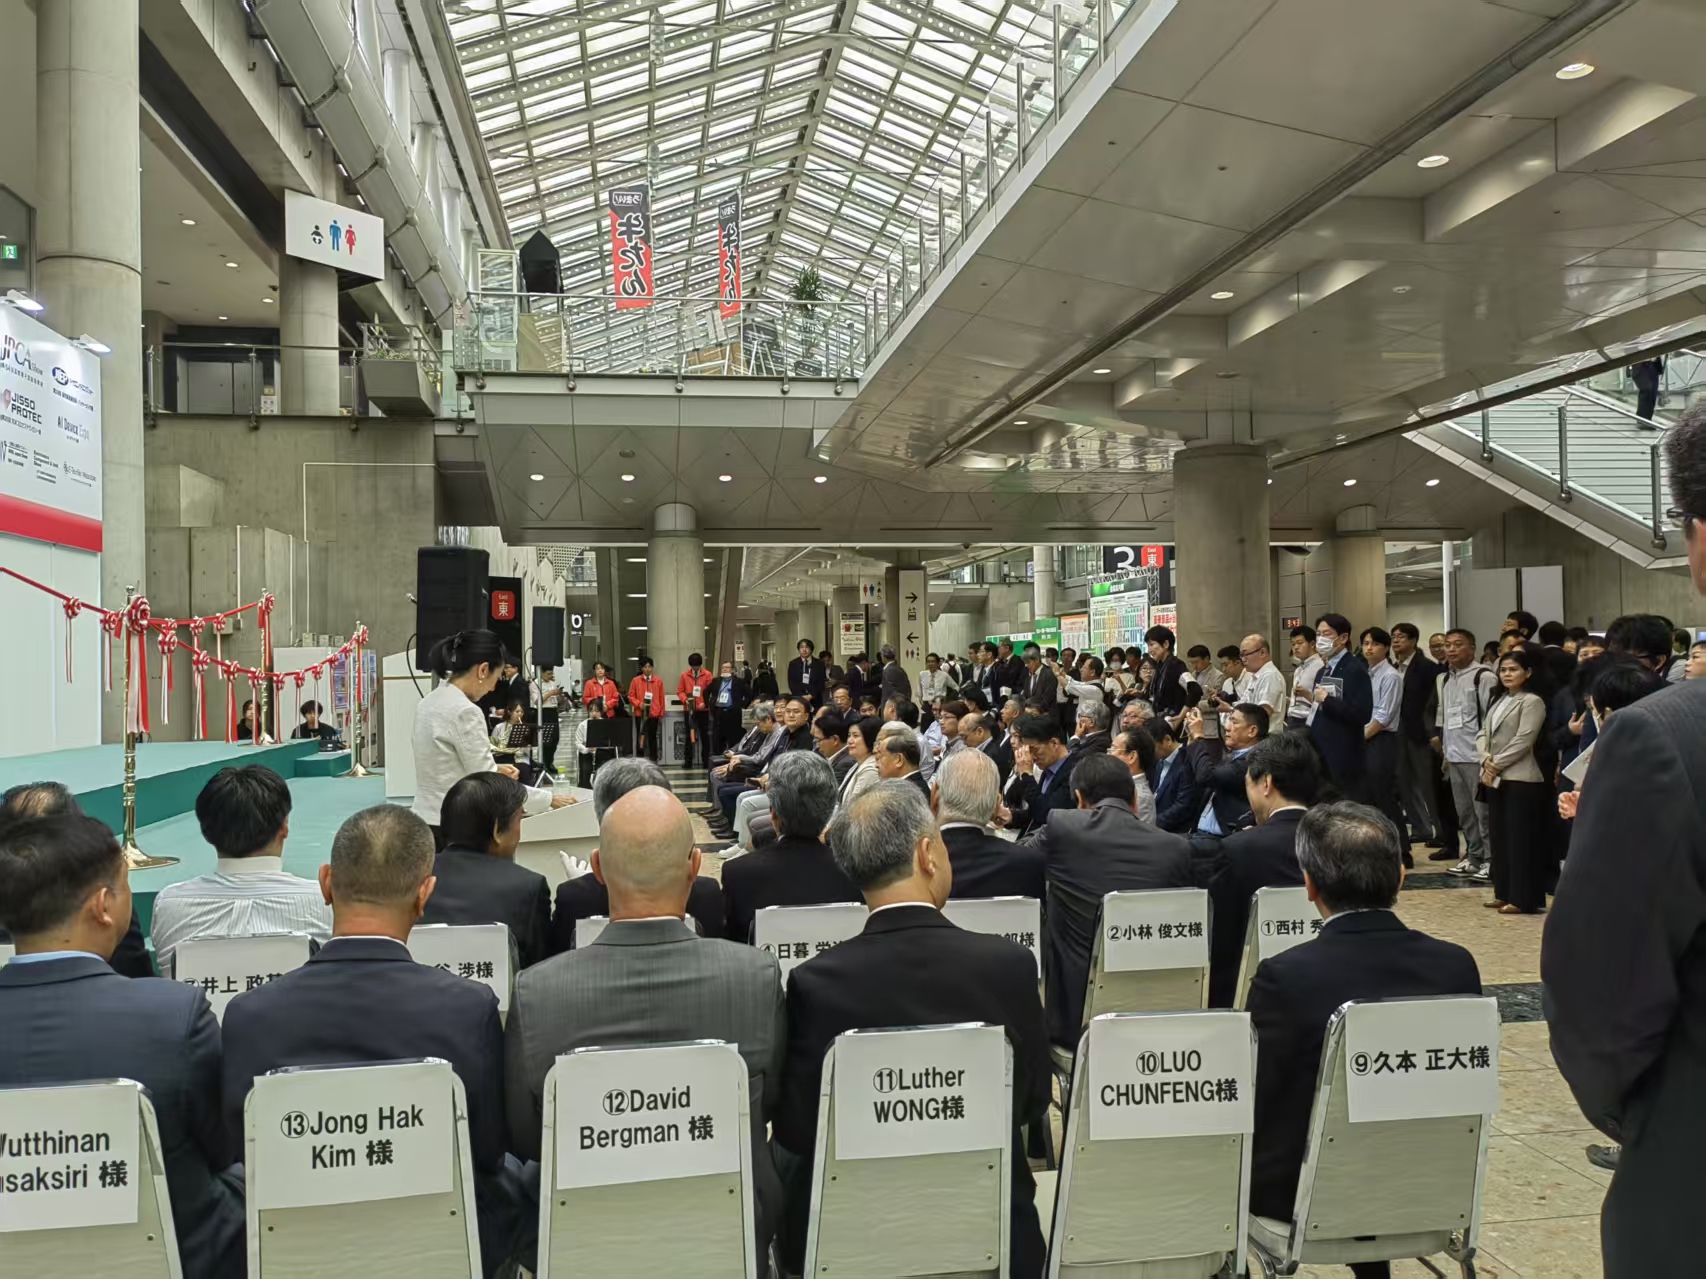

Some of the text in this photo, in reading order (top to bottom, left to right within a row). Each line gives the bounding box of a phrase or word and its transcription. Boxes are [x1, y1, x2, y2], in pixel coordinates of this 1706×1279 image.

[11, 393, 36, 411] JISSO
[11, 403, 42, 424] PROTEC
[1113, 546, 1135, 576] 3
[1147, 553, 1157, 567] 東
[498, 602, 508, 617] 東
[1107, 921, 1203, 941] ②小林 俊文様
[1261, 918, 1305, 936] ①西村
[1135, 1049, 1202, 1076] ⑩LUO
[1349, 1045, 1491, 1077] ⑨久本 正大様
[872, 1067, 966, 1094] ⑪Luther
[1100, 1078, 1239, 1108] CHUNFENG様
[601, 1085, 691, 1117] ⑫David
[873, 1098, 966, 1124] WONG様
[280, 1103, 425, 1140] ⑬Jong Hak
[579, 1114, 715, 1150] Bergman 様
[311, 1139, 394, 1170] Kim 様
[98, 1159, 129, 1189] 様
